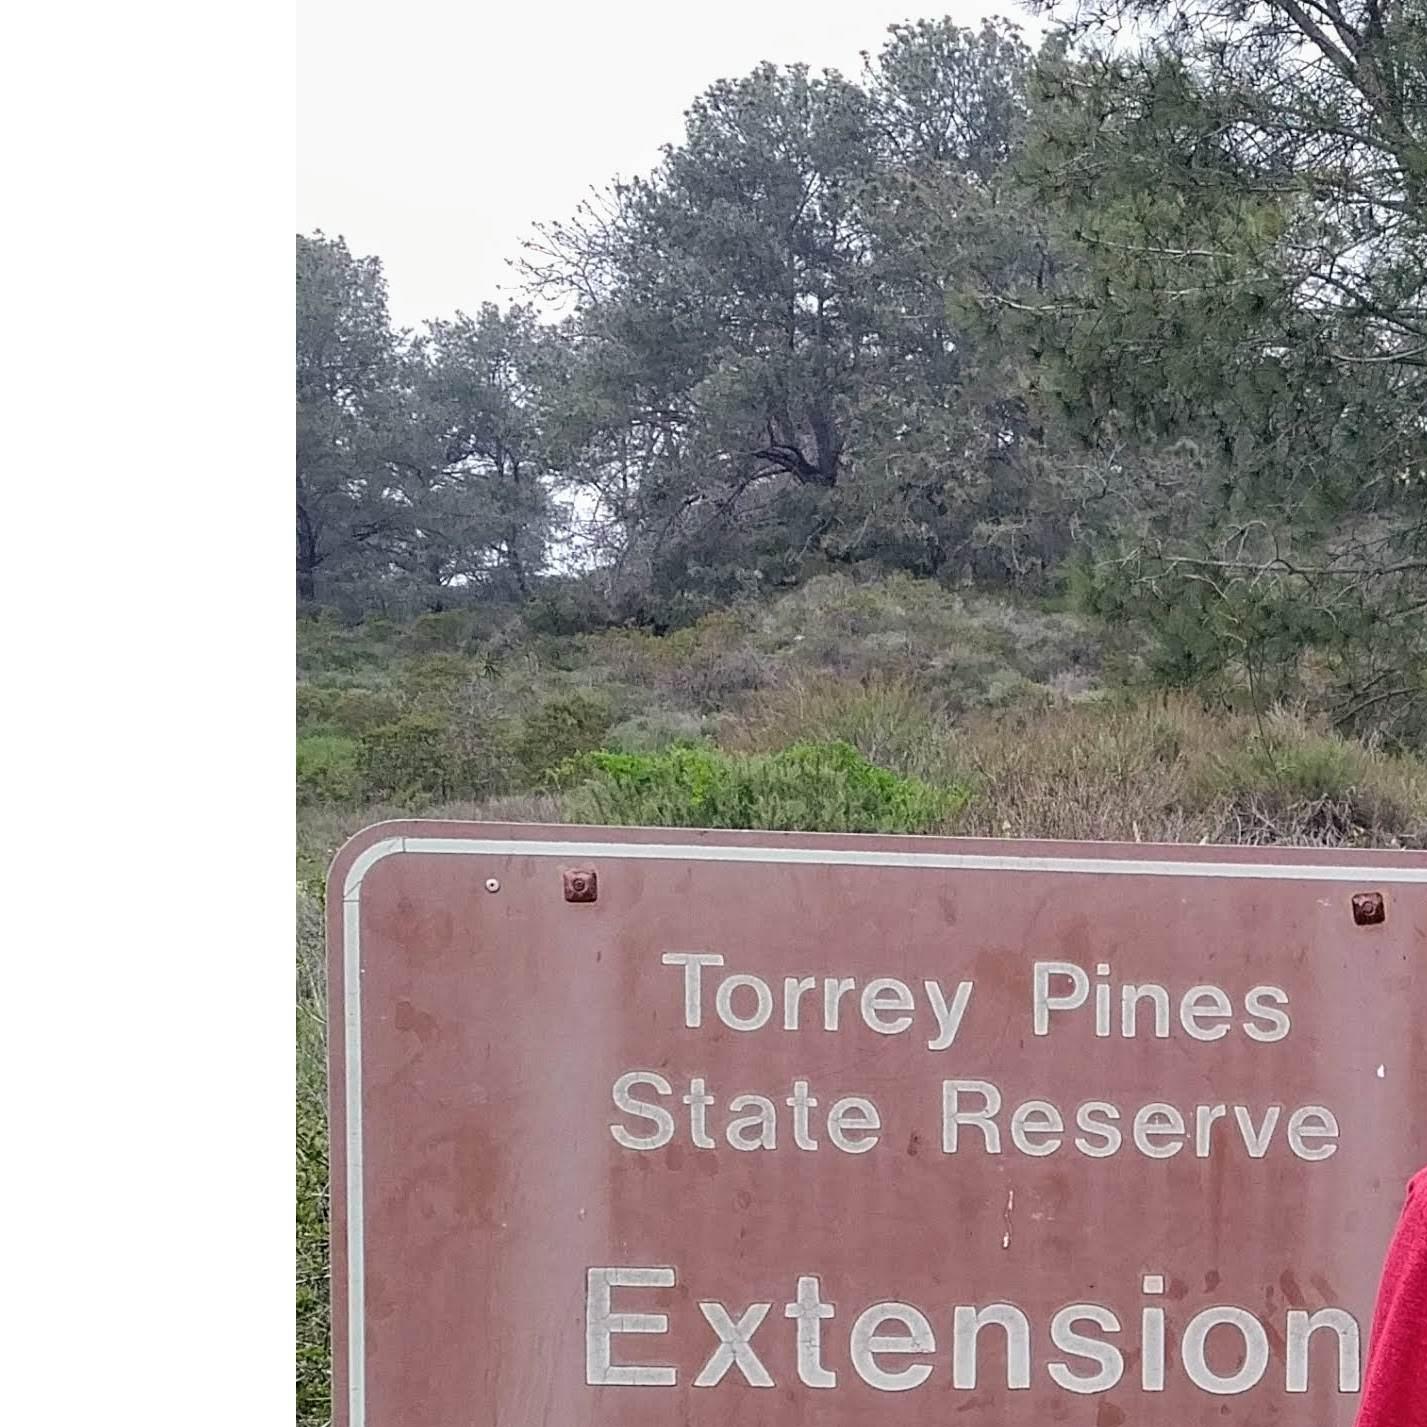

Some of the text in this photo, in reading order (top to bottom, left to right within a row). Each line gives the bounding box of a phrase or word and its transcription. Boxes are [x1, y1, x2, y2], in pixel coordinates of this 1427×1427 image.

[661, 952, 1291, 1051] Torrey Pines
[609, 1071, 1340, 1161] State Reserve
[584, 1266, 1362, 1394] Extension
